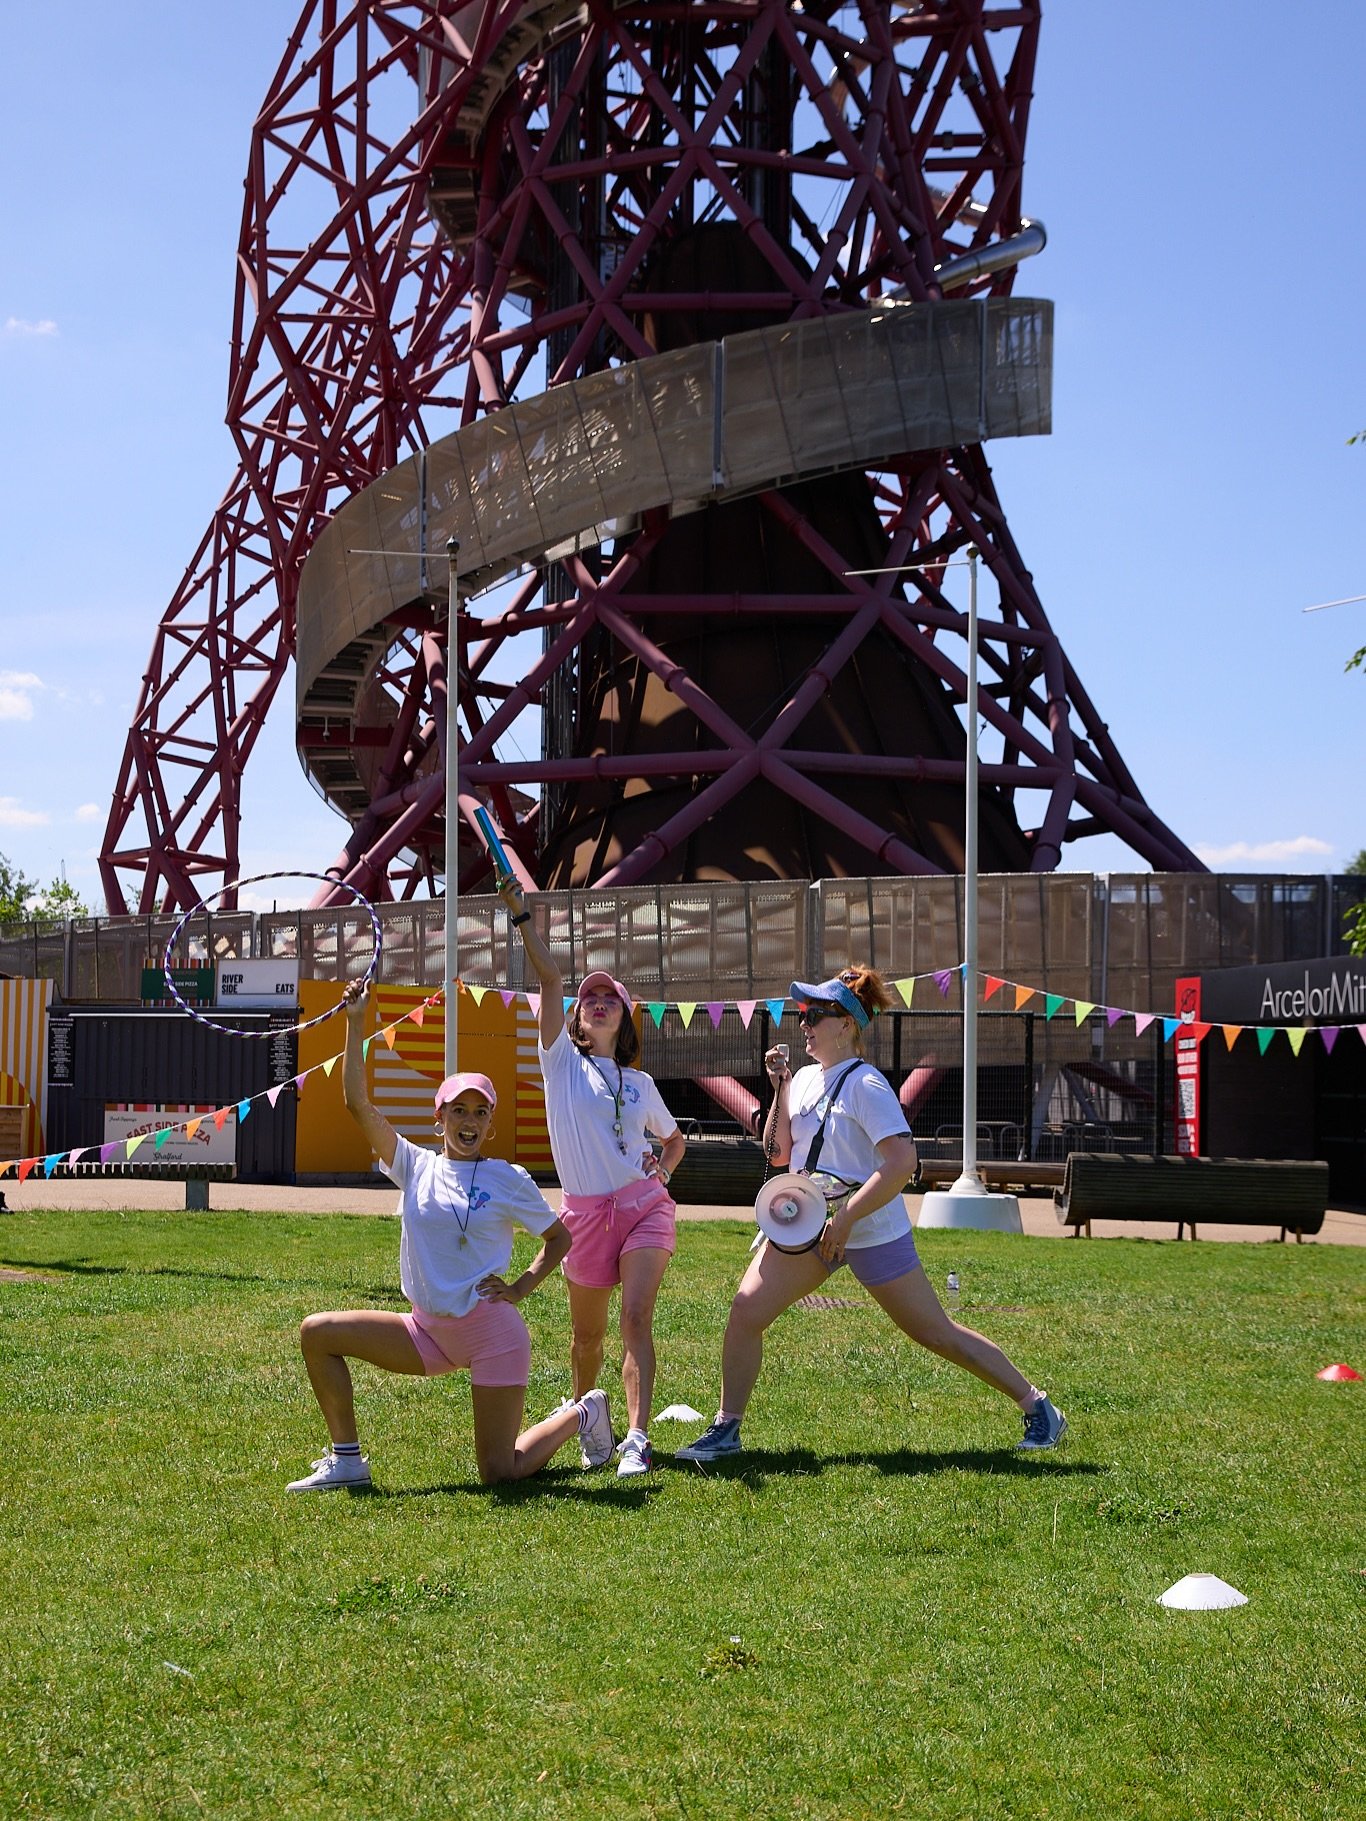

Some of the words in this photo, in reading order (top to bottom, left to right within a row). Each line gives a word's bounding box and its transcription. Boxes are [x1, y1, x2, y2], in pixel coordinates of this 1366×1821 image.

[222, 974, 244, 984] RIVER
[222, 984, 238, 993] SIDE
[275, 983, 295, 993] EATS
[1260, 970, 1366, 1019] ArcelorMit
